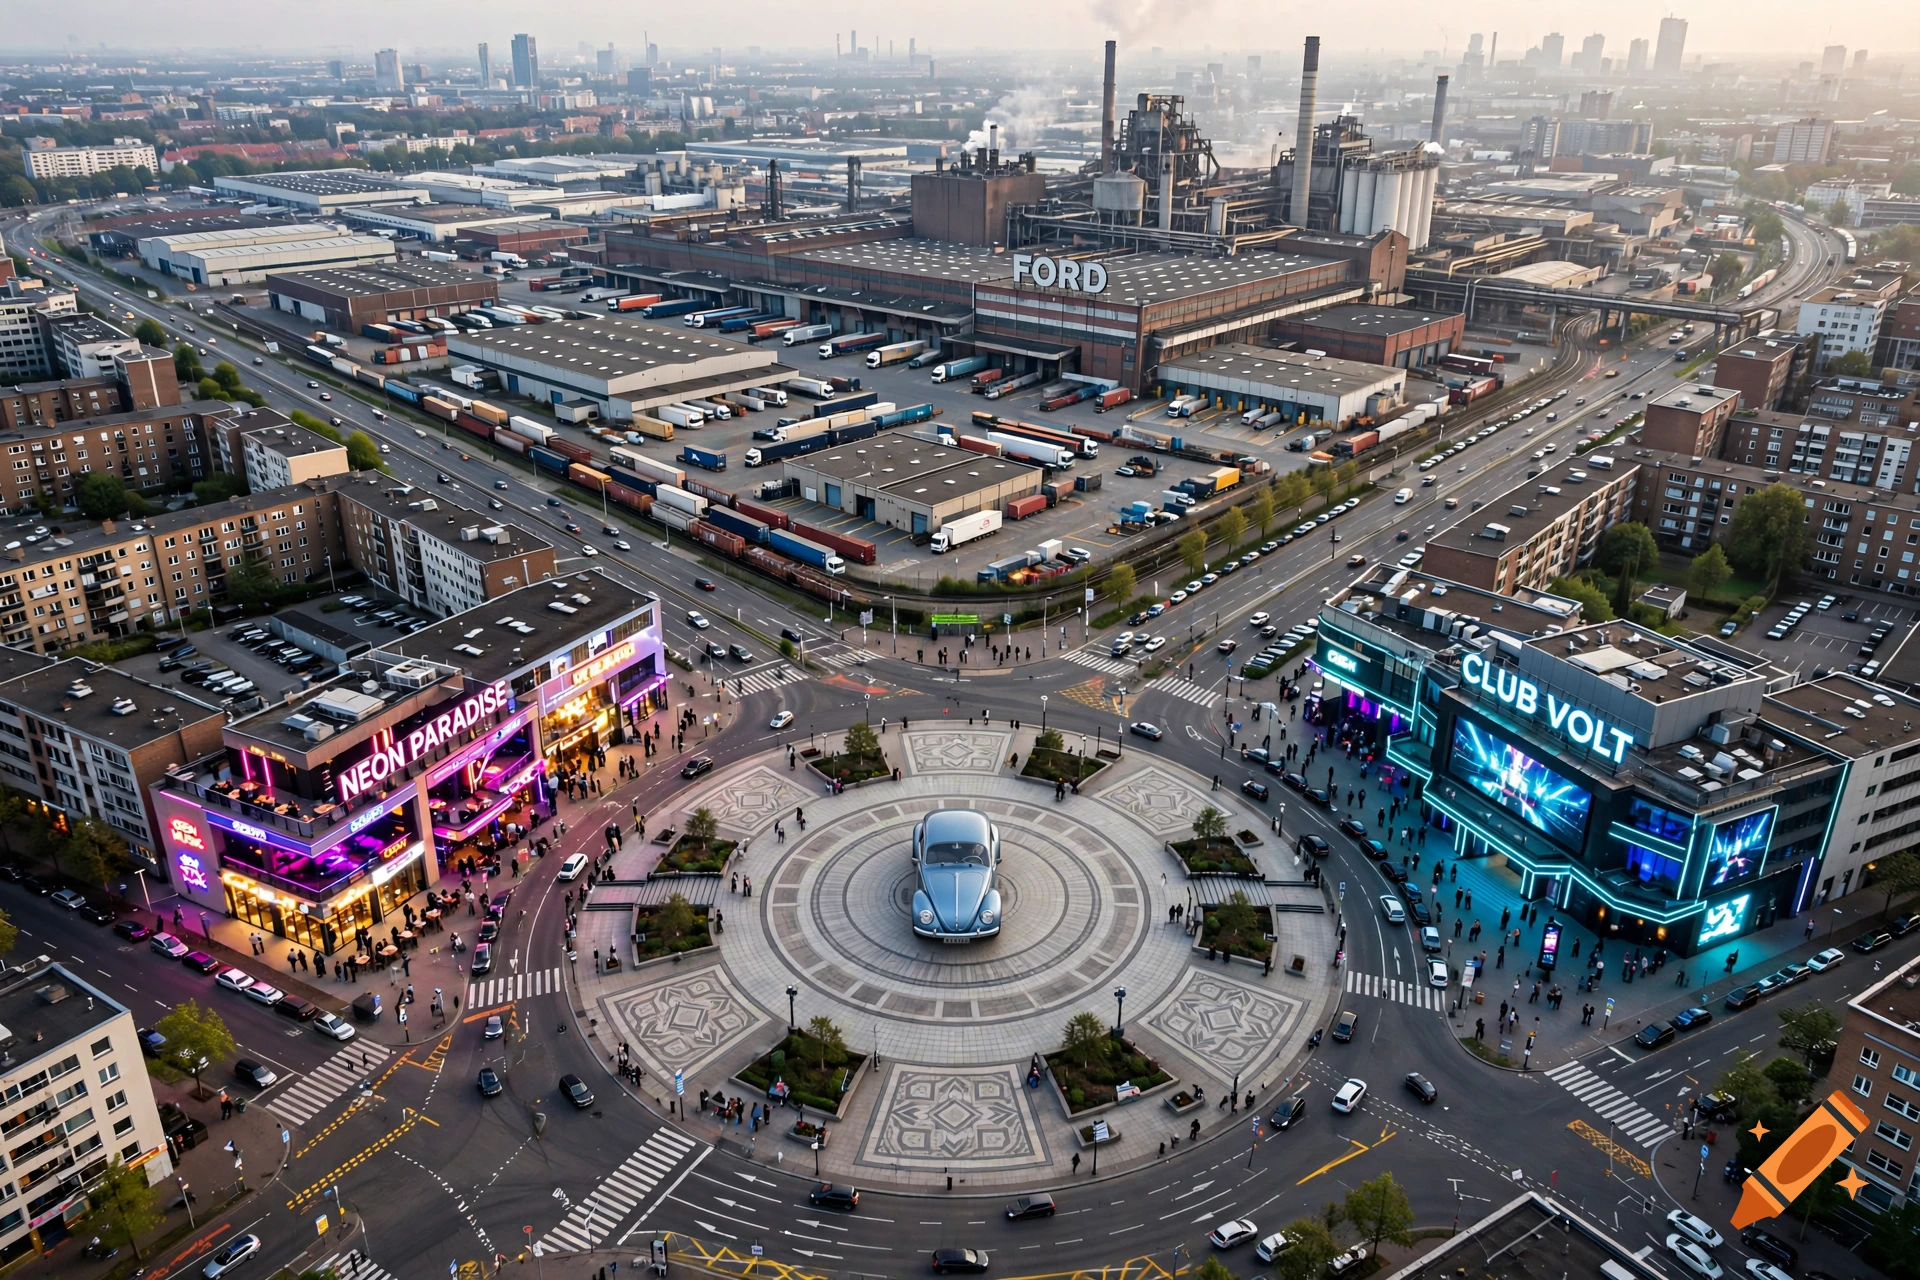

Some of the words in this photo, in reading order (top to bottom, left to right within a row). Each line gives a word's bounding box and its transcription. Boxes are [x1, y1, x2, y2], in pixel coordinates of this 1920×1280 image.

[1013, 253, 1108, 294] FORD
[339, 740, 406, 802] NEON
[409, 680, 508, 761] PARADISE
[1462, 653, 1538, 714] CLUB
[1547, 693, 1634, 764] VOLT
